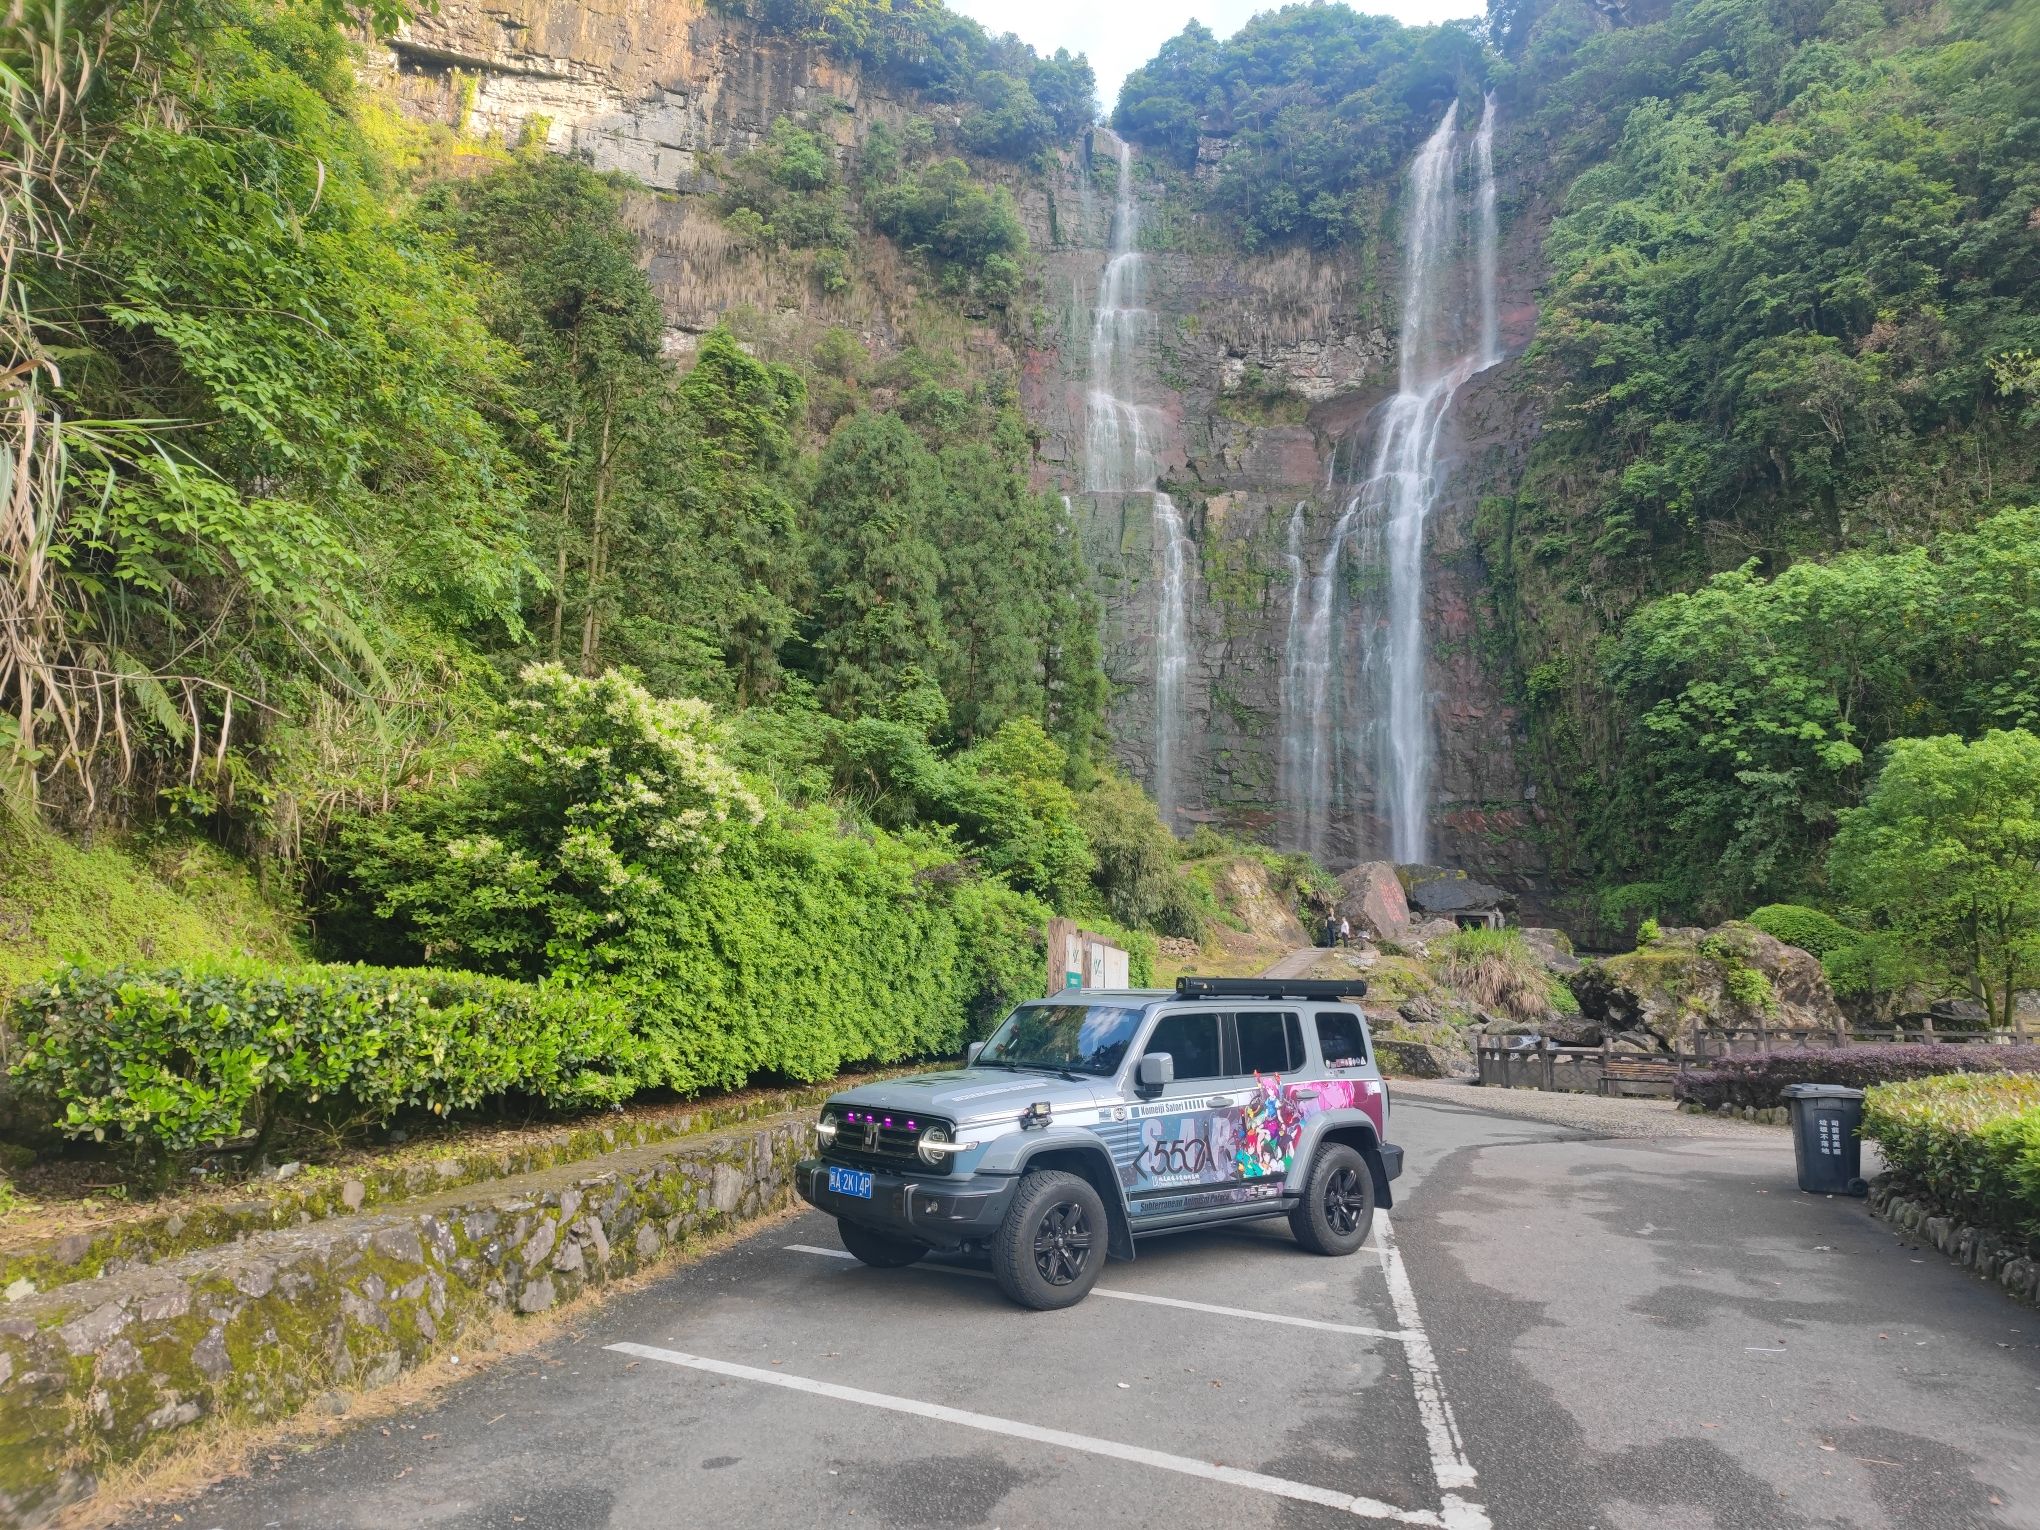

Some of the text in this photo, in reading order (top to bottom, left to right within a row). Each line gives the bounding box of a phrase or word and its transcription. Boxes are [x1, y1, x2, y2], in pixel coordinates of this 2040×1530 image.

[1141, 1101, 1184, 1116] Komeiji Satori
[1819, 1119, 1830, 1155] 垃圾不落地
[1831, 1119, 1841, 1155] 司前更美丽
[1140, 1199, 1183, 1212] Subterranean
